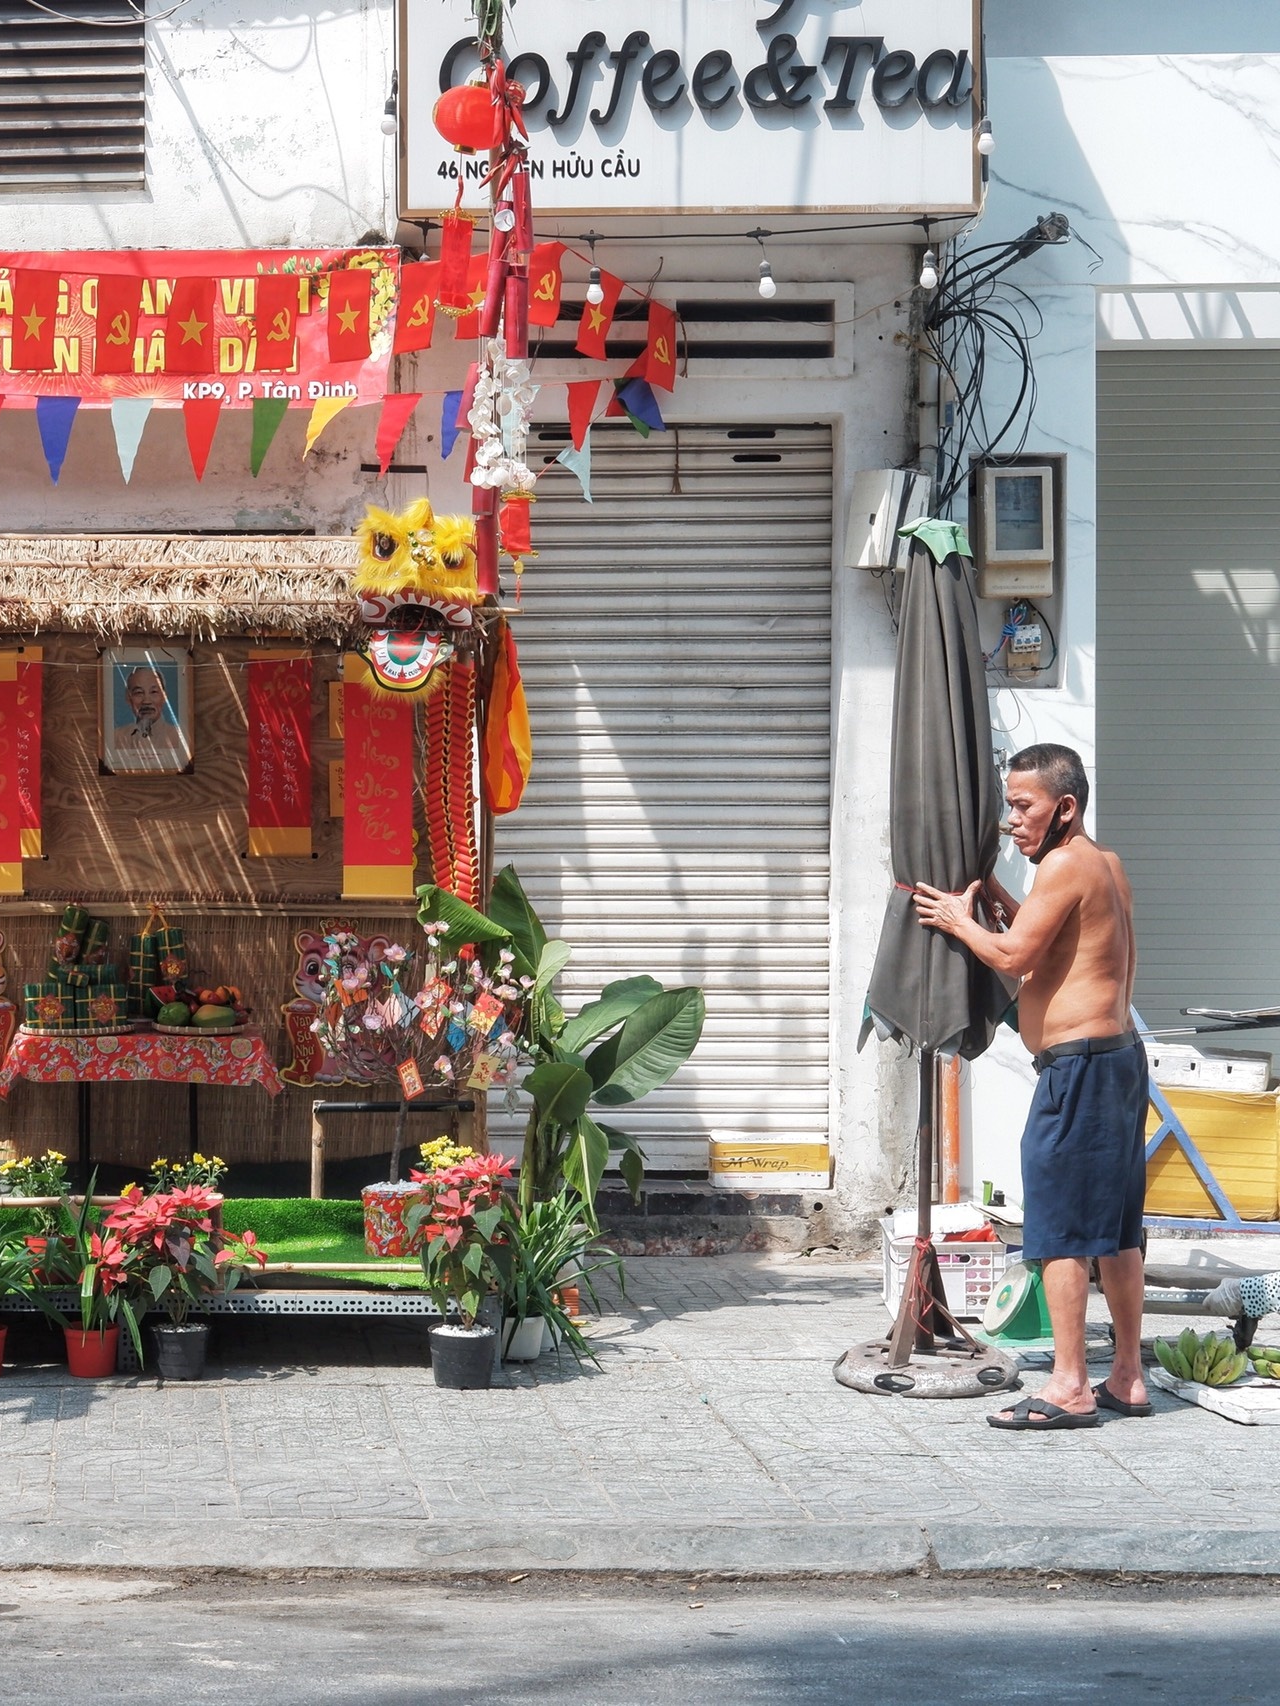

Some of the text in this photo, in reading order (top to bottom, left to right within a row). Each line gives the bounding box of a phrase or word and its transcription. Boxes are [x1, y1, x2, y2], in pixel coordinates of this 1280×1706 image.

[437, 160, 459, 179] 46
[552, 151, 593, 179] HỮU
[600, 149, 640, 179] CẦU
[261, 380, 301, 399] Tân
